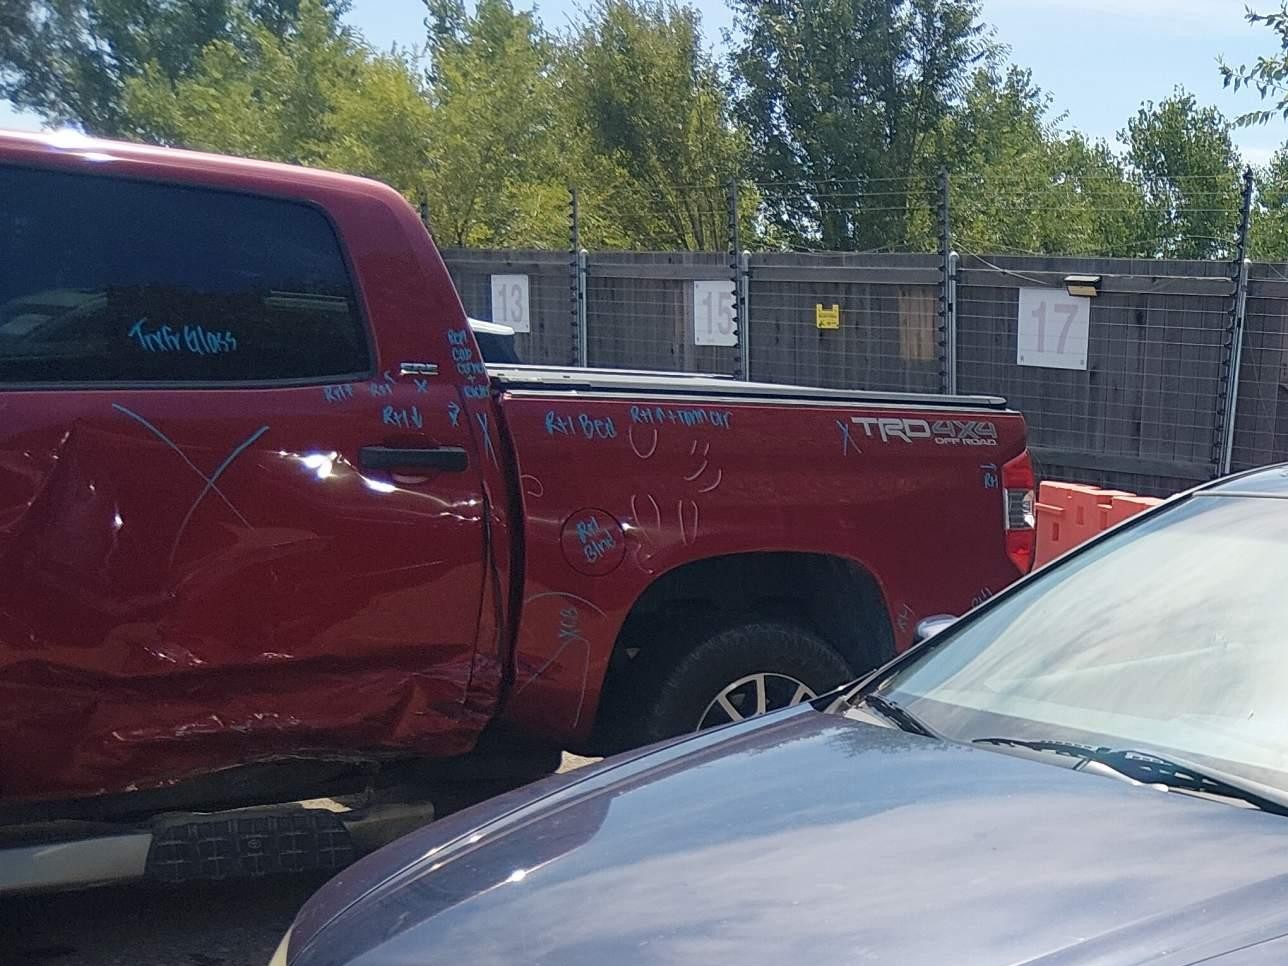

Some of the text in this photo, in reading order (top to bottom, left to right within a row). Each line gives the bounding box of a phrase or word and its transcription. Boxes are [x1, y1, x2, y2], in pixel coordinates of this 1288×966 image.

[497, 284, 523, 323] 13
[702, 290, 732, 336] 15
[1031, 301, 1079, 354] 17
[851, 416, 931, 443] TRD
[934, 437, 998, 447] OFF ROAD
